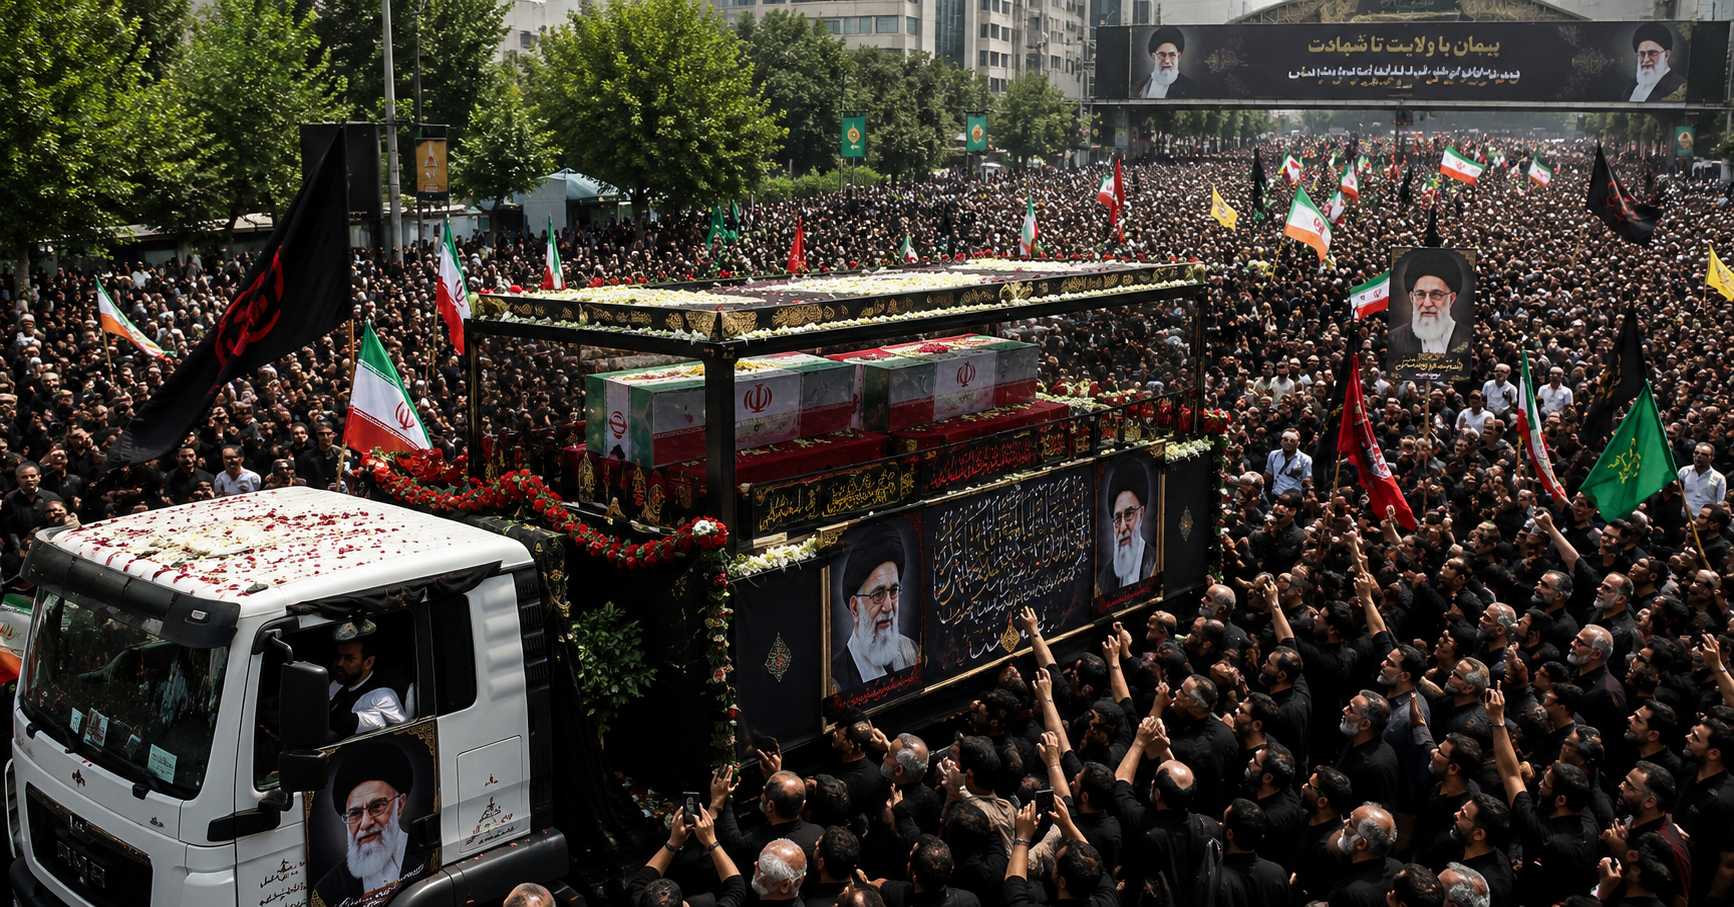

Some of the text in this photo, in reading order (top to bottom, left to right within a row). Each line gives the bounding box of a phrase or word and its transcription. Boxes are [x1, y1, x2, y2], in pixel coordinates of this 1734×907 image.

[1370, 36, 1384, 53] تا
[1386, 36, 1436, 57] ولایت
[1439, 36, 1451, 57] با
[1454, 36, 1500, 57] پیمان
